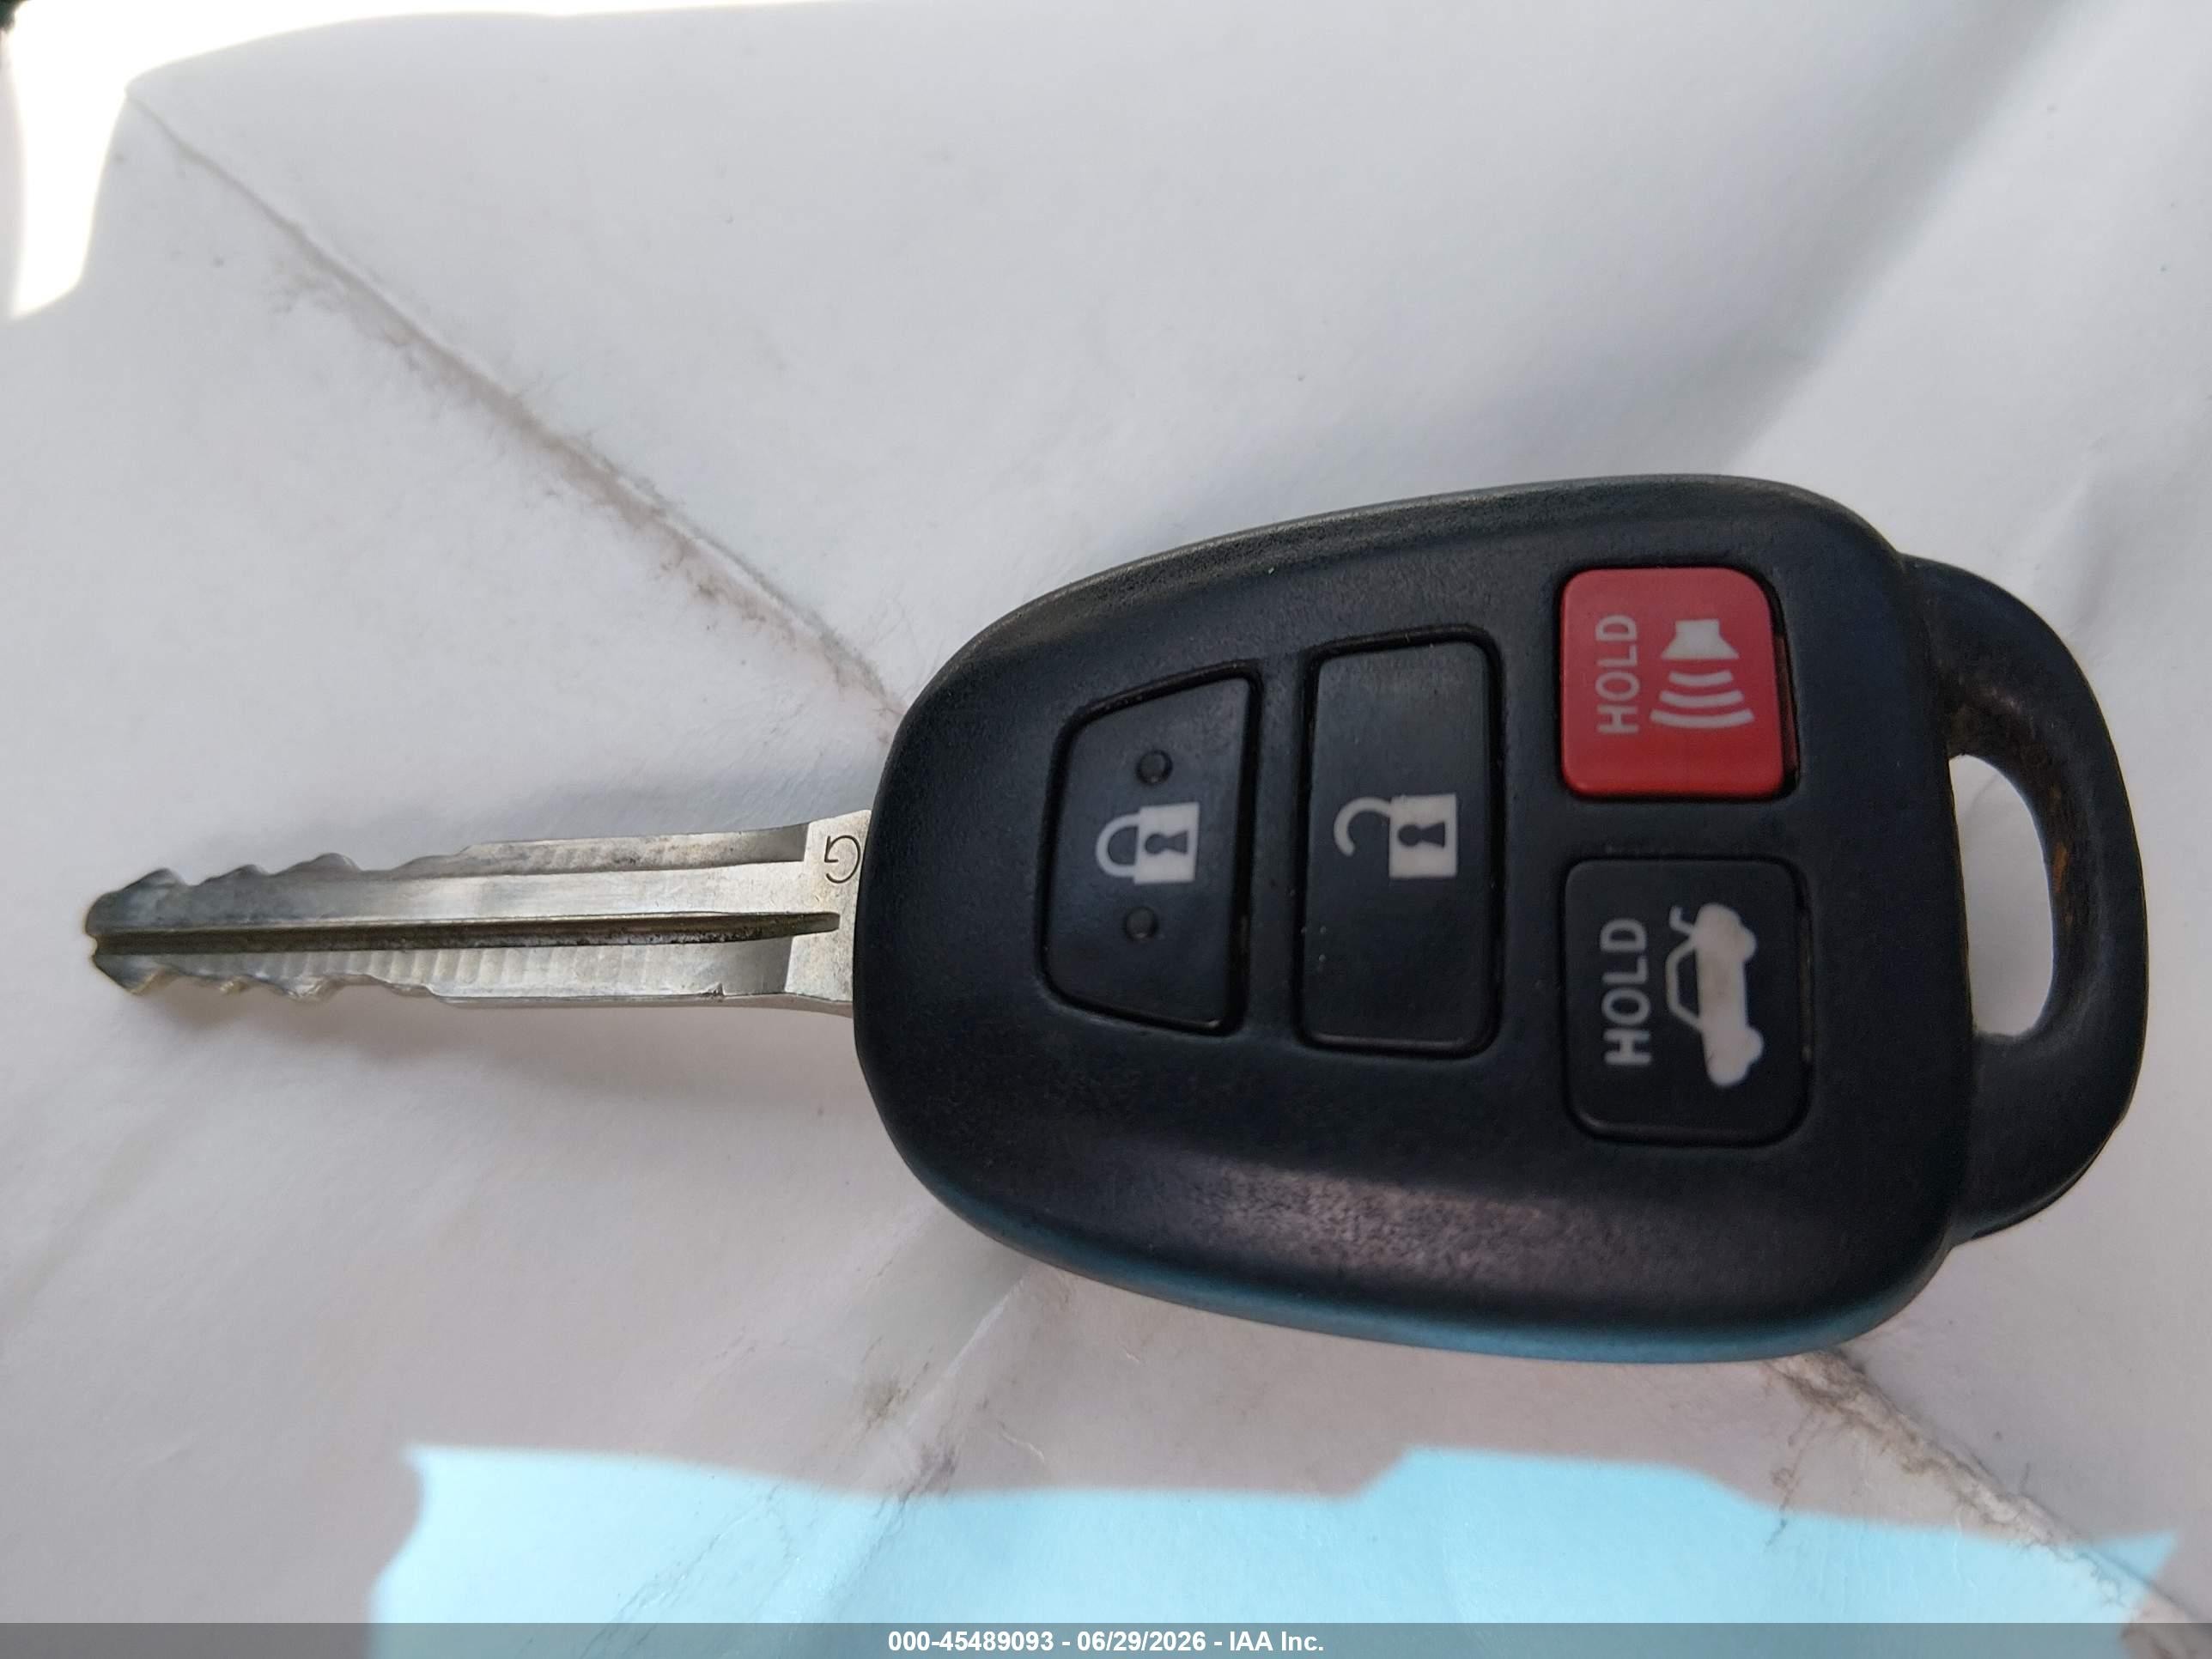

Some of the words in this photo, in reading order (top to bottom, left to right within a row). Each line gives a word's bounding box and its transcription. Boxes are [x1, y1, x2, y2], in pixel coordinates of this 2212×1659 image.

[1595, 614, 1639, 734] HOLD
[823, 834, 862, 884] G
[1601, 918, 1652, 1067] HOLD
